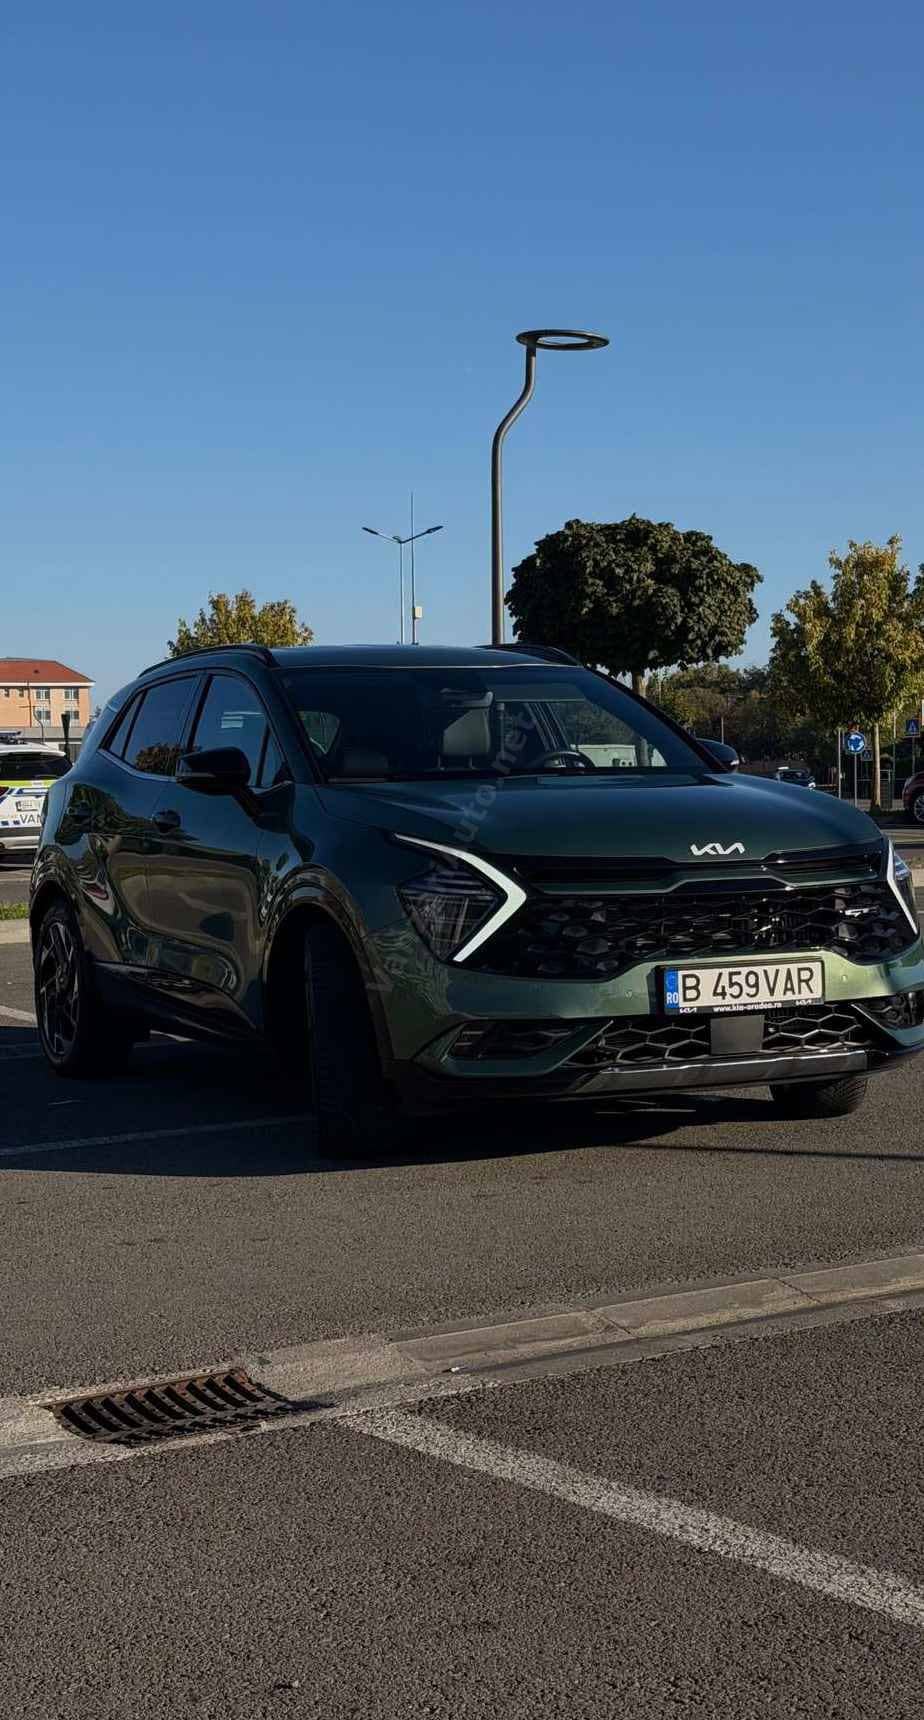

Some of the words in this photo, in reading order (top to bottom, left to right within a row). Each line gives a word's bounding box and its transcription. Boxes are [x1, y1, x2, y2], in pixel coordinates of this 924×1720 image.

[690, 842, 745, 856] KIA
[681, 973, 701, 1003] B
[666, 991, 679, 1004] RO
